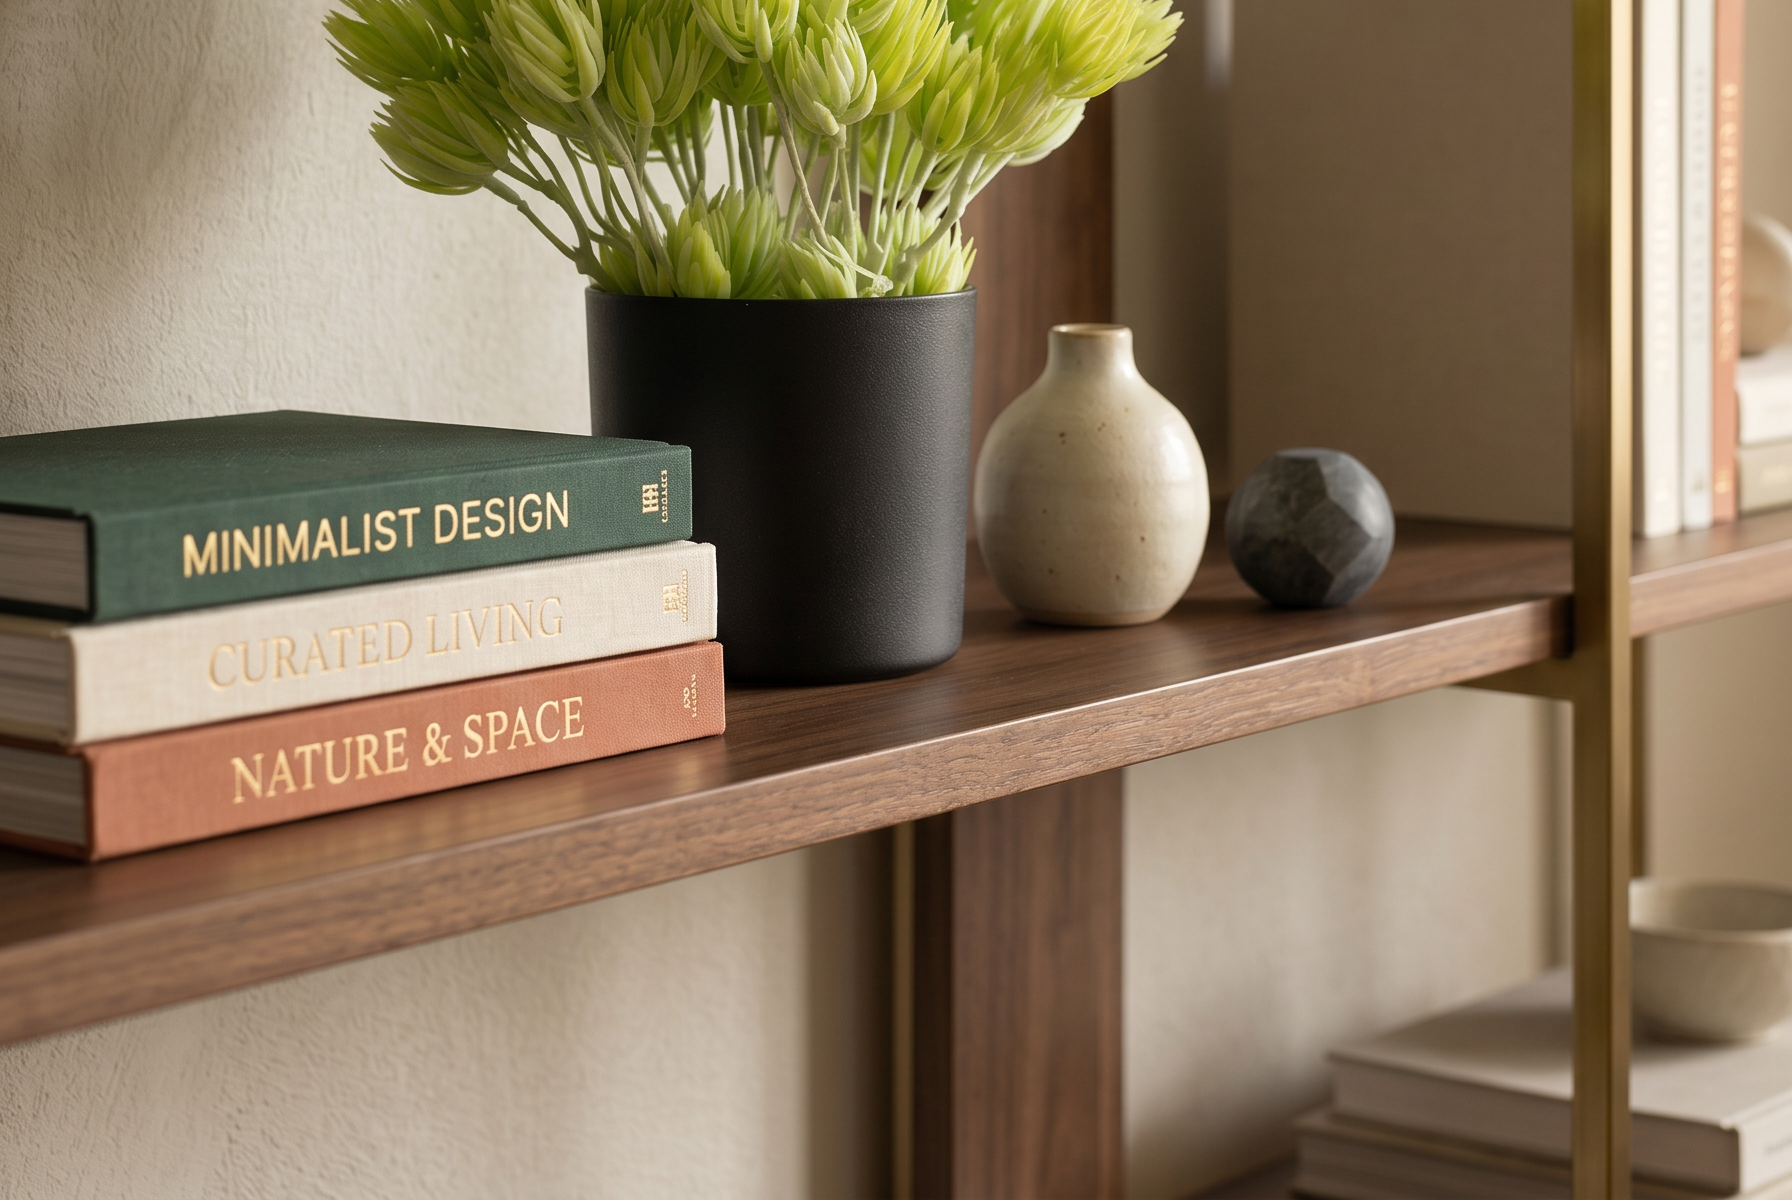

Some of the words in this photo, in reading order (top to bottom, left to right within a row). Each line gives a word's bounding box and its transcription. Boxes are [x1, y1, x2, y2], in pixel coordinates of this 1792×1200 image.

[183, 507, 421, 578] MINIMALIST
[434, 489, 569, 544] DESIGN
[208, 620, 413, 692] CURATED
[426, 597, 563, 657] LIVING
[230, 727, 409, 804] NATURE
[422, 722, 452, 767] &
[463, 696, 585, 759] SPACE
